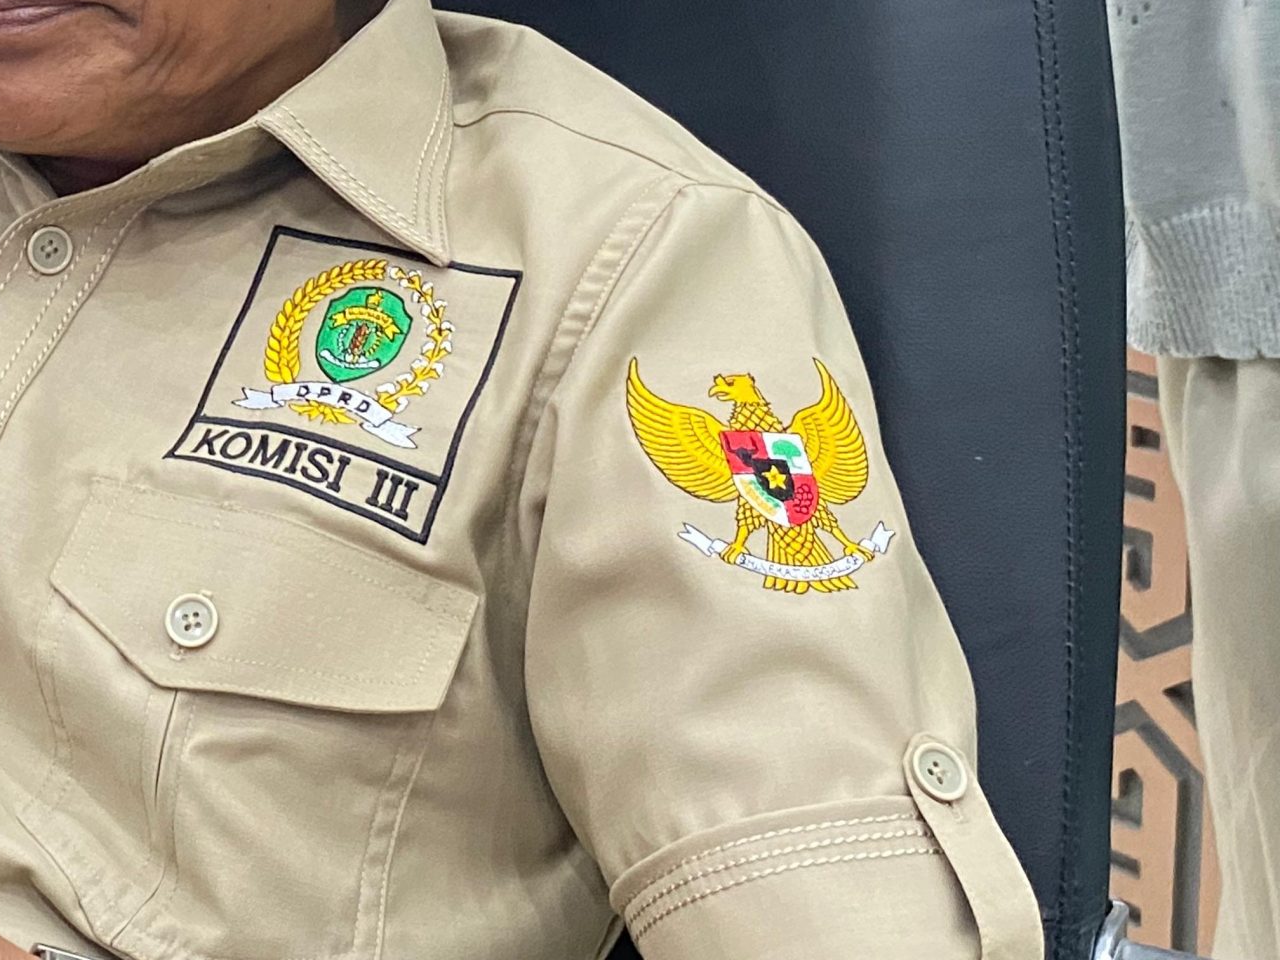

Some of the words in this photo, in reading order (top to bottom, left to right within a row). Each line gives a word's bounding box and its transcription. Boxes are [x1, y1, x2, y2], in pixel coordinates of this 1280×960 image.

[296, 384, 372, 413] DPRD
[191, 428, 351, 492] KOMISI
[365, 468, 420, 521] III
